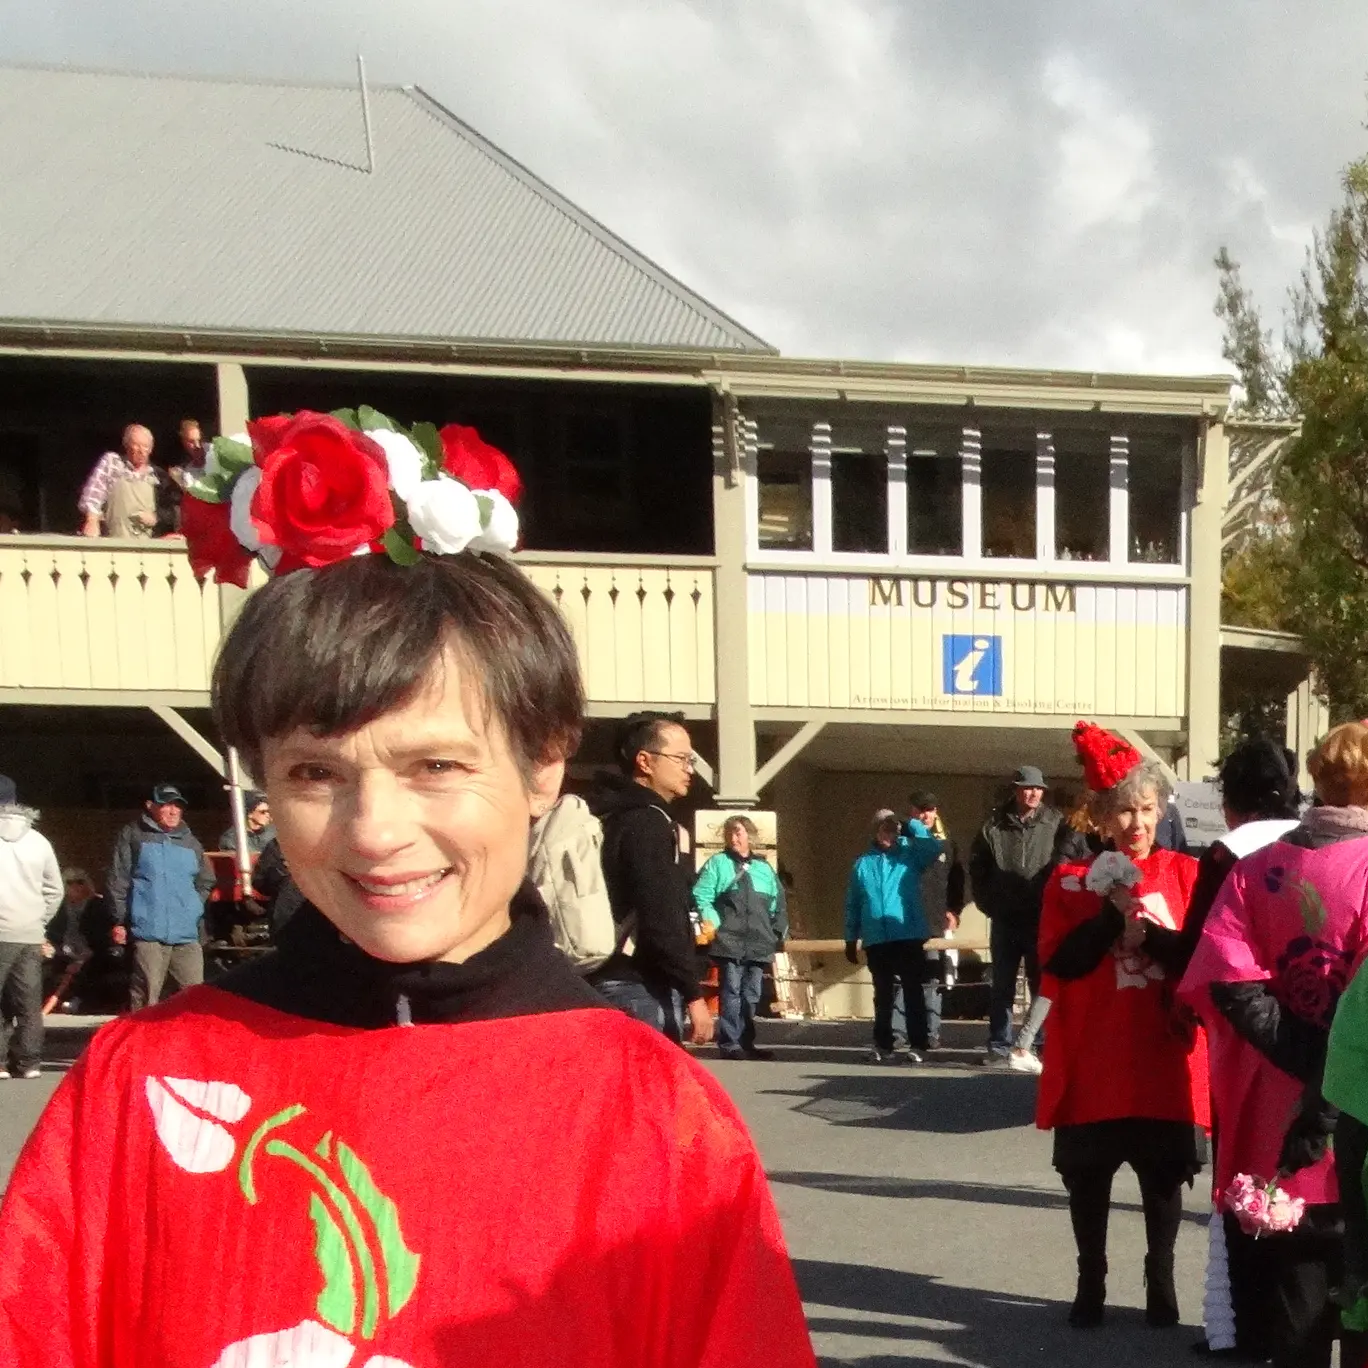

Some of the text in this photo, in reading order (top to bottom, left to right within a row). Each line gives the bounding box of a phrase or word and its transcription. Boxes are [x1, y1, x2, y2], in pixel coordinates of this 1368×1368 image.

[870, 576, 1077, 612] MUSEUM
[853, 694, 918, 706] Arrowtown
[922, 695, 989, 708] Information
[993, 698, 1002, 708] &
[1056, 699, 1092, 711] Centre
